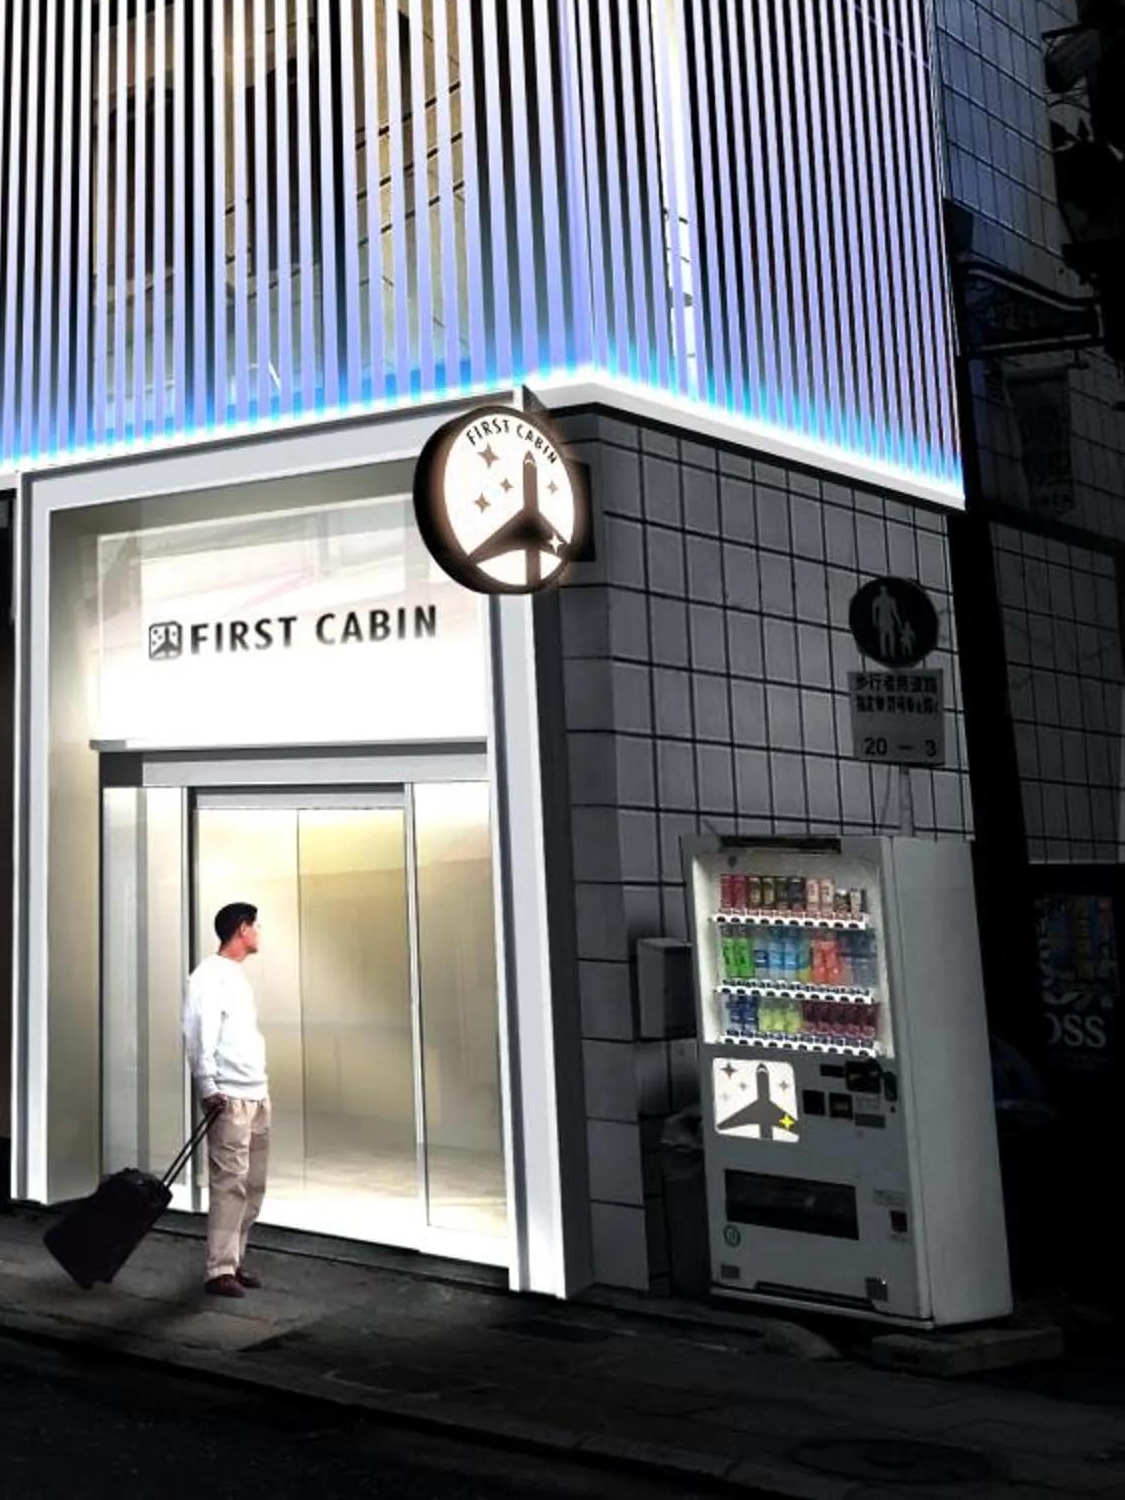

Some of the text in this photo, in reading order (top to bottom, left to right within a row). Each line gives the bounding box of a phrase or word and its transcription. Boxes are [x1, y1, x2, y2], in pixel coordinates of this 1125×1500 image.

[466, 418, 558, 466] FIRST CABIN
[190, 604, 438, 656] FIRST CABIN
[1043, 1011, 1108, 1050] OSS
